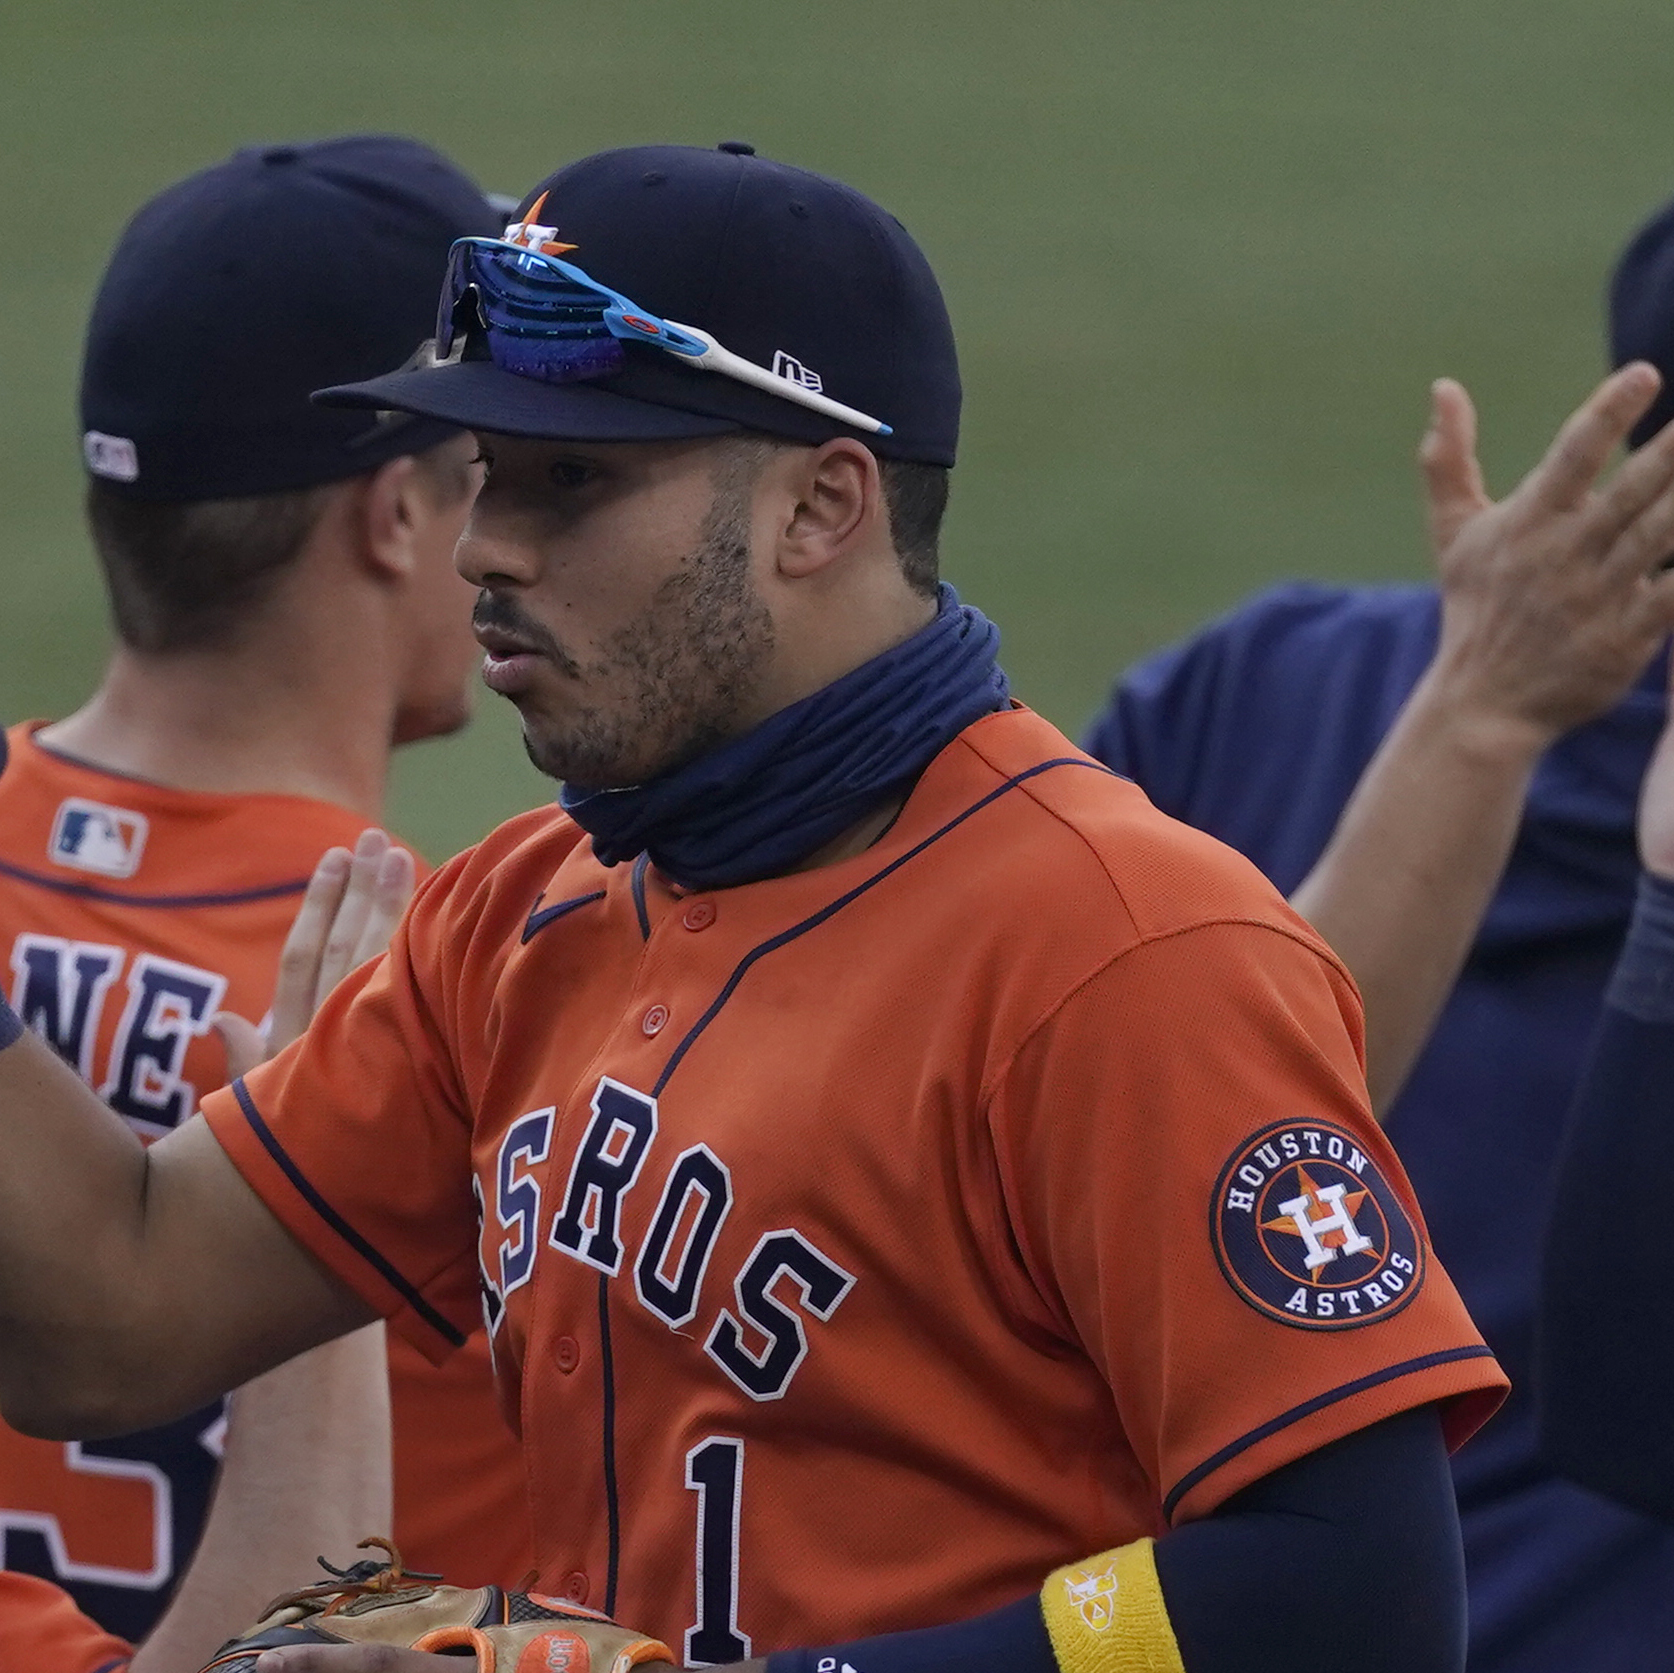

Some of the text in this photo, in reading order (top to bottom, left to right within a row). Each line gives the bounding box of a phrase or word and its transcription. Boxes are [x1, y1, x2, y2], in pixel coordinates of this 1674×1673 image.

[10, 932, 273, 1140] NE
[1227, 1130, 1369, 1213] HOUSTON
[1285, 1251, 1415, 1317] ASTROS
[683, 1435, 752, 1669] 1
